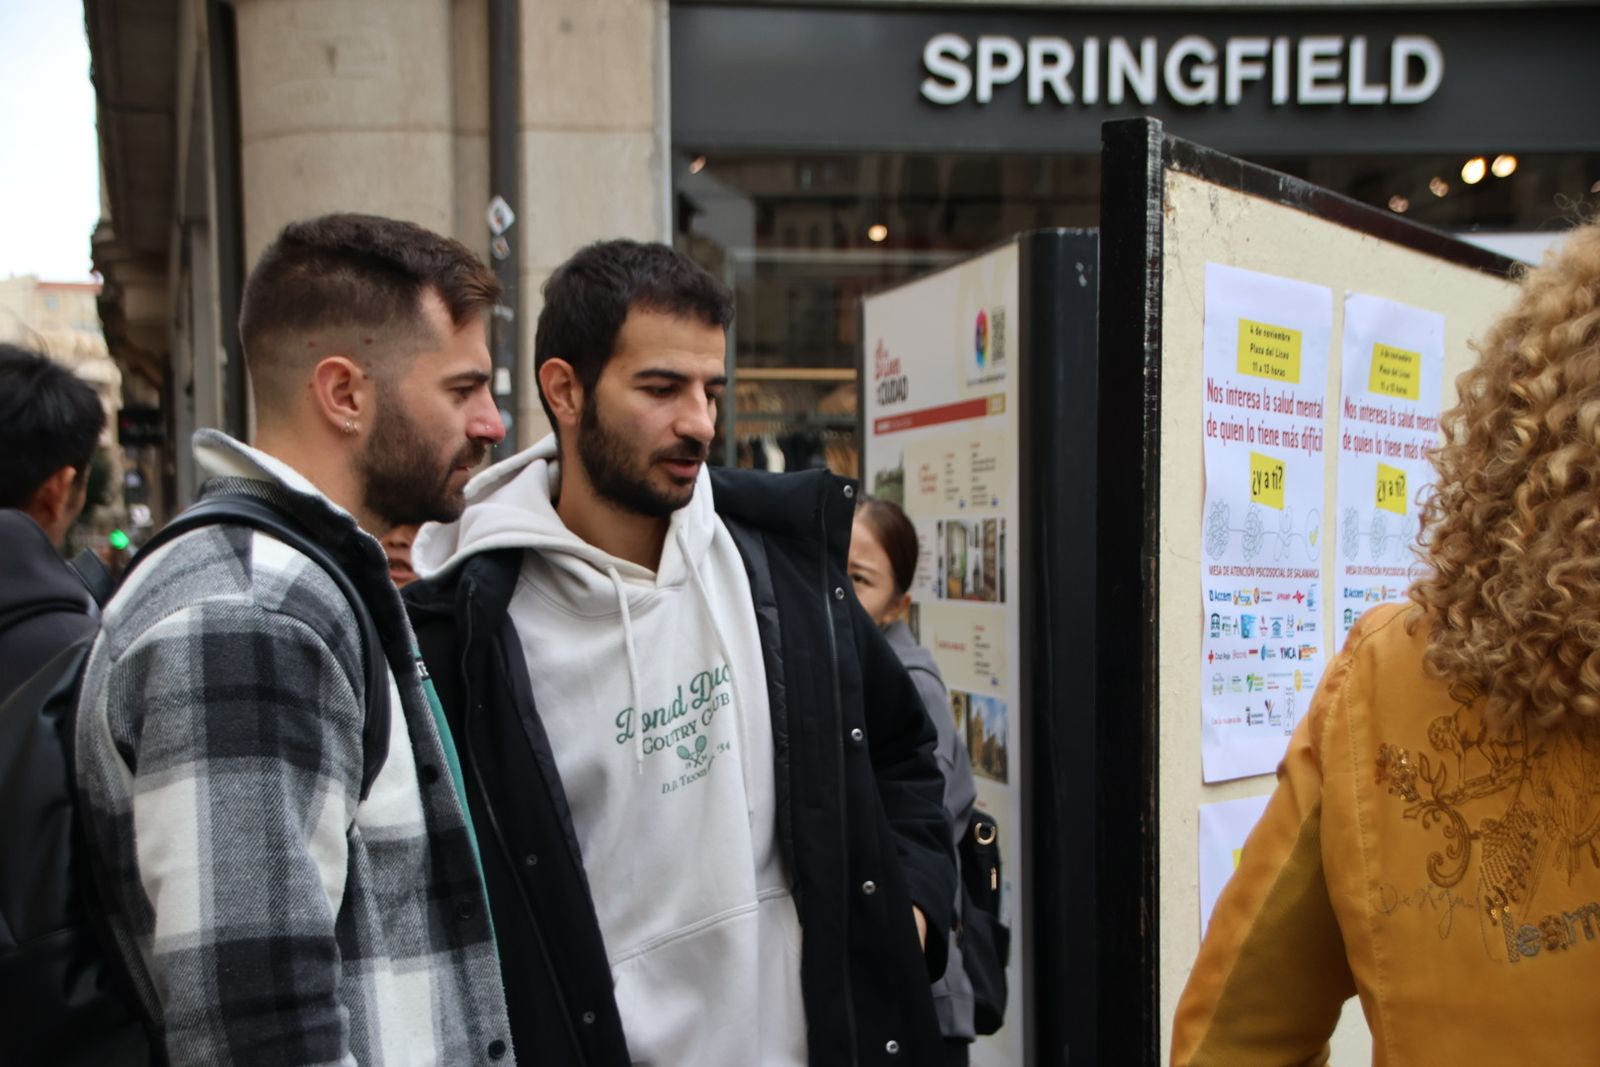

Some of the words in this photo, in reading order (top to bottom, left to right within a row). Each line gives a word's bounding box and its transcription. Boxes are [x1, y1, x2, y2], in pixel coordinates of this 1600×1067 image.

[921, 34, 1444, 104] SPRINGFIELD
[1255, 326, 1262, 336] de
[1263, 329, 1291, 342] noviembre
[1250, 342, 1264, 355] Plaza
[1265, 347, 1274, 357] del
[1252, 361, 1258, 371] 11
[1271, 365, 1286, 377] horas
[1207, 377, 1223, 404] Nos
[1226, 380, 1260, 410] interesa
[1263, 386, 1270, 412] la
[1273, 390, 1294, 415] salud
[1296, 395, 1324, 419] mental
[1344, 395, 1357, 419] Nos
[1359, 398, 1387, 425] interesa
[1389, 404, 1395, 426] la
[1398, 406, 1415, 429] salud
[1206, 411, 1217, 438] de
[1220, 415, 1244, 447] quien
[1247, 417, 1254, 443] lo
[1258, 419, 1279, 447] tiene
[1282, 424, 1299, 449] más
[1343, 426, 1351, 451] de
[1354, 429, 1373, 458] quien
[1384, 433, 1401, 458] tiene
[1264, 471, 1270, 489] a
[1389, 480, 1393, 496] a
[1208, 564, 1222, 576] MESA
[1223, 565, 1230, 576] DE
